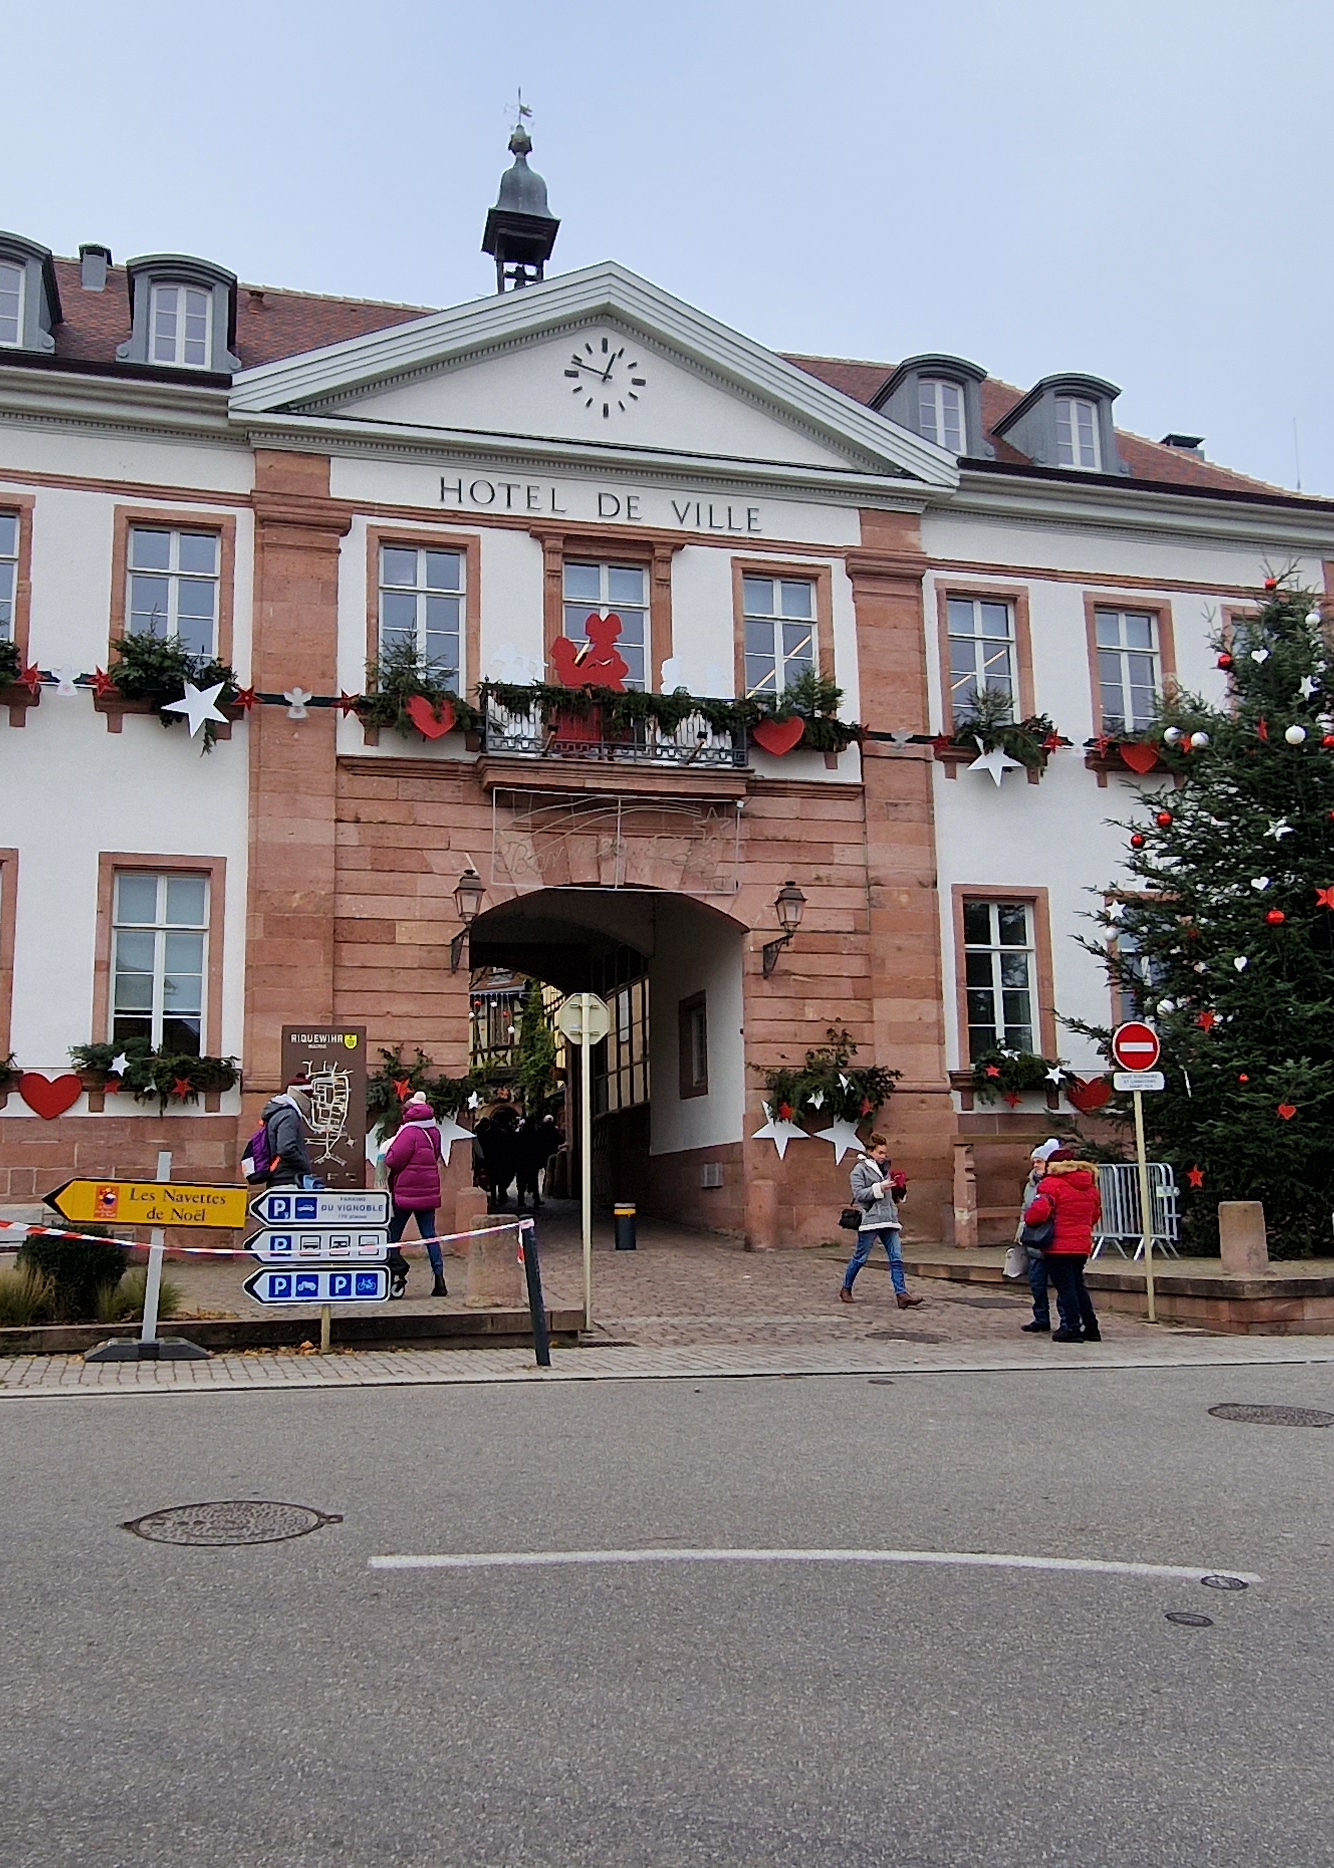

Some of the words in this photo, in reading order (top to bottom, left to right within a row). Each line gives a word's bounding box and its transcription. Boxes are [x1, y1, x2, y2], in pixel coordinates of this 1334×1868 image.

[440, 476, 567, 513] HOTEL
[598, 492, 643, 520] DE
[671, 500, 763, 532] VILLE
[290, 1033, 344, 1044] RIQUEWIHR
[130, 1187, 156, 1202] Les
[163, 1189, 227, 1205] Navettes
[147, 1207, 164, 1220] de
[171, 1208, 206, 1222] Noël
[321, 1204, 334, 1212] DU
[337, 1204, 384, 1212] VIGNOBLE
